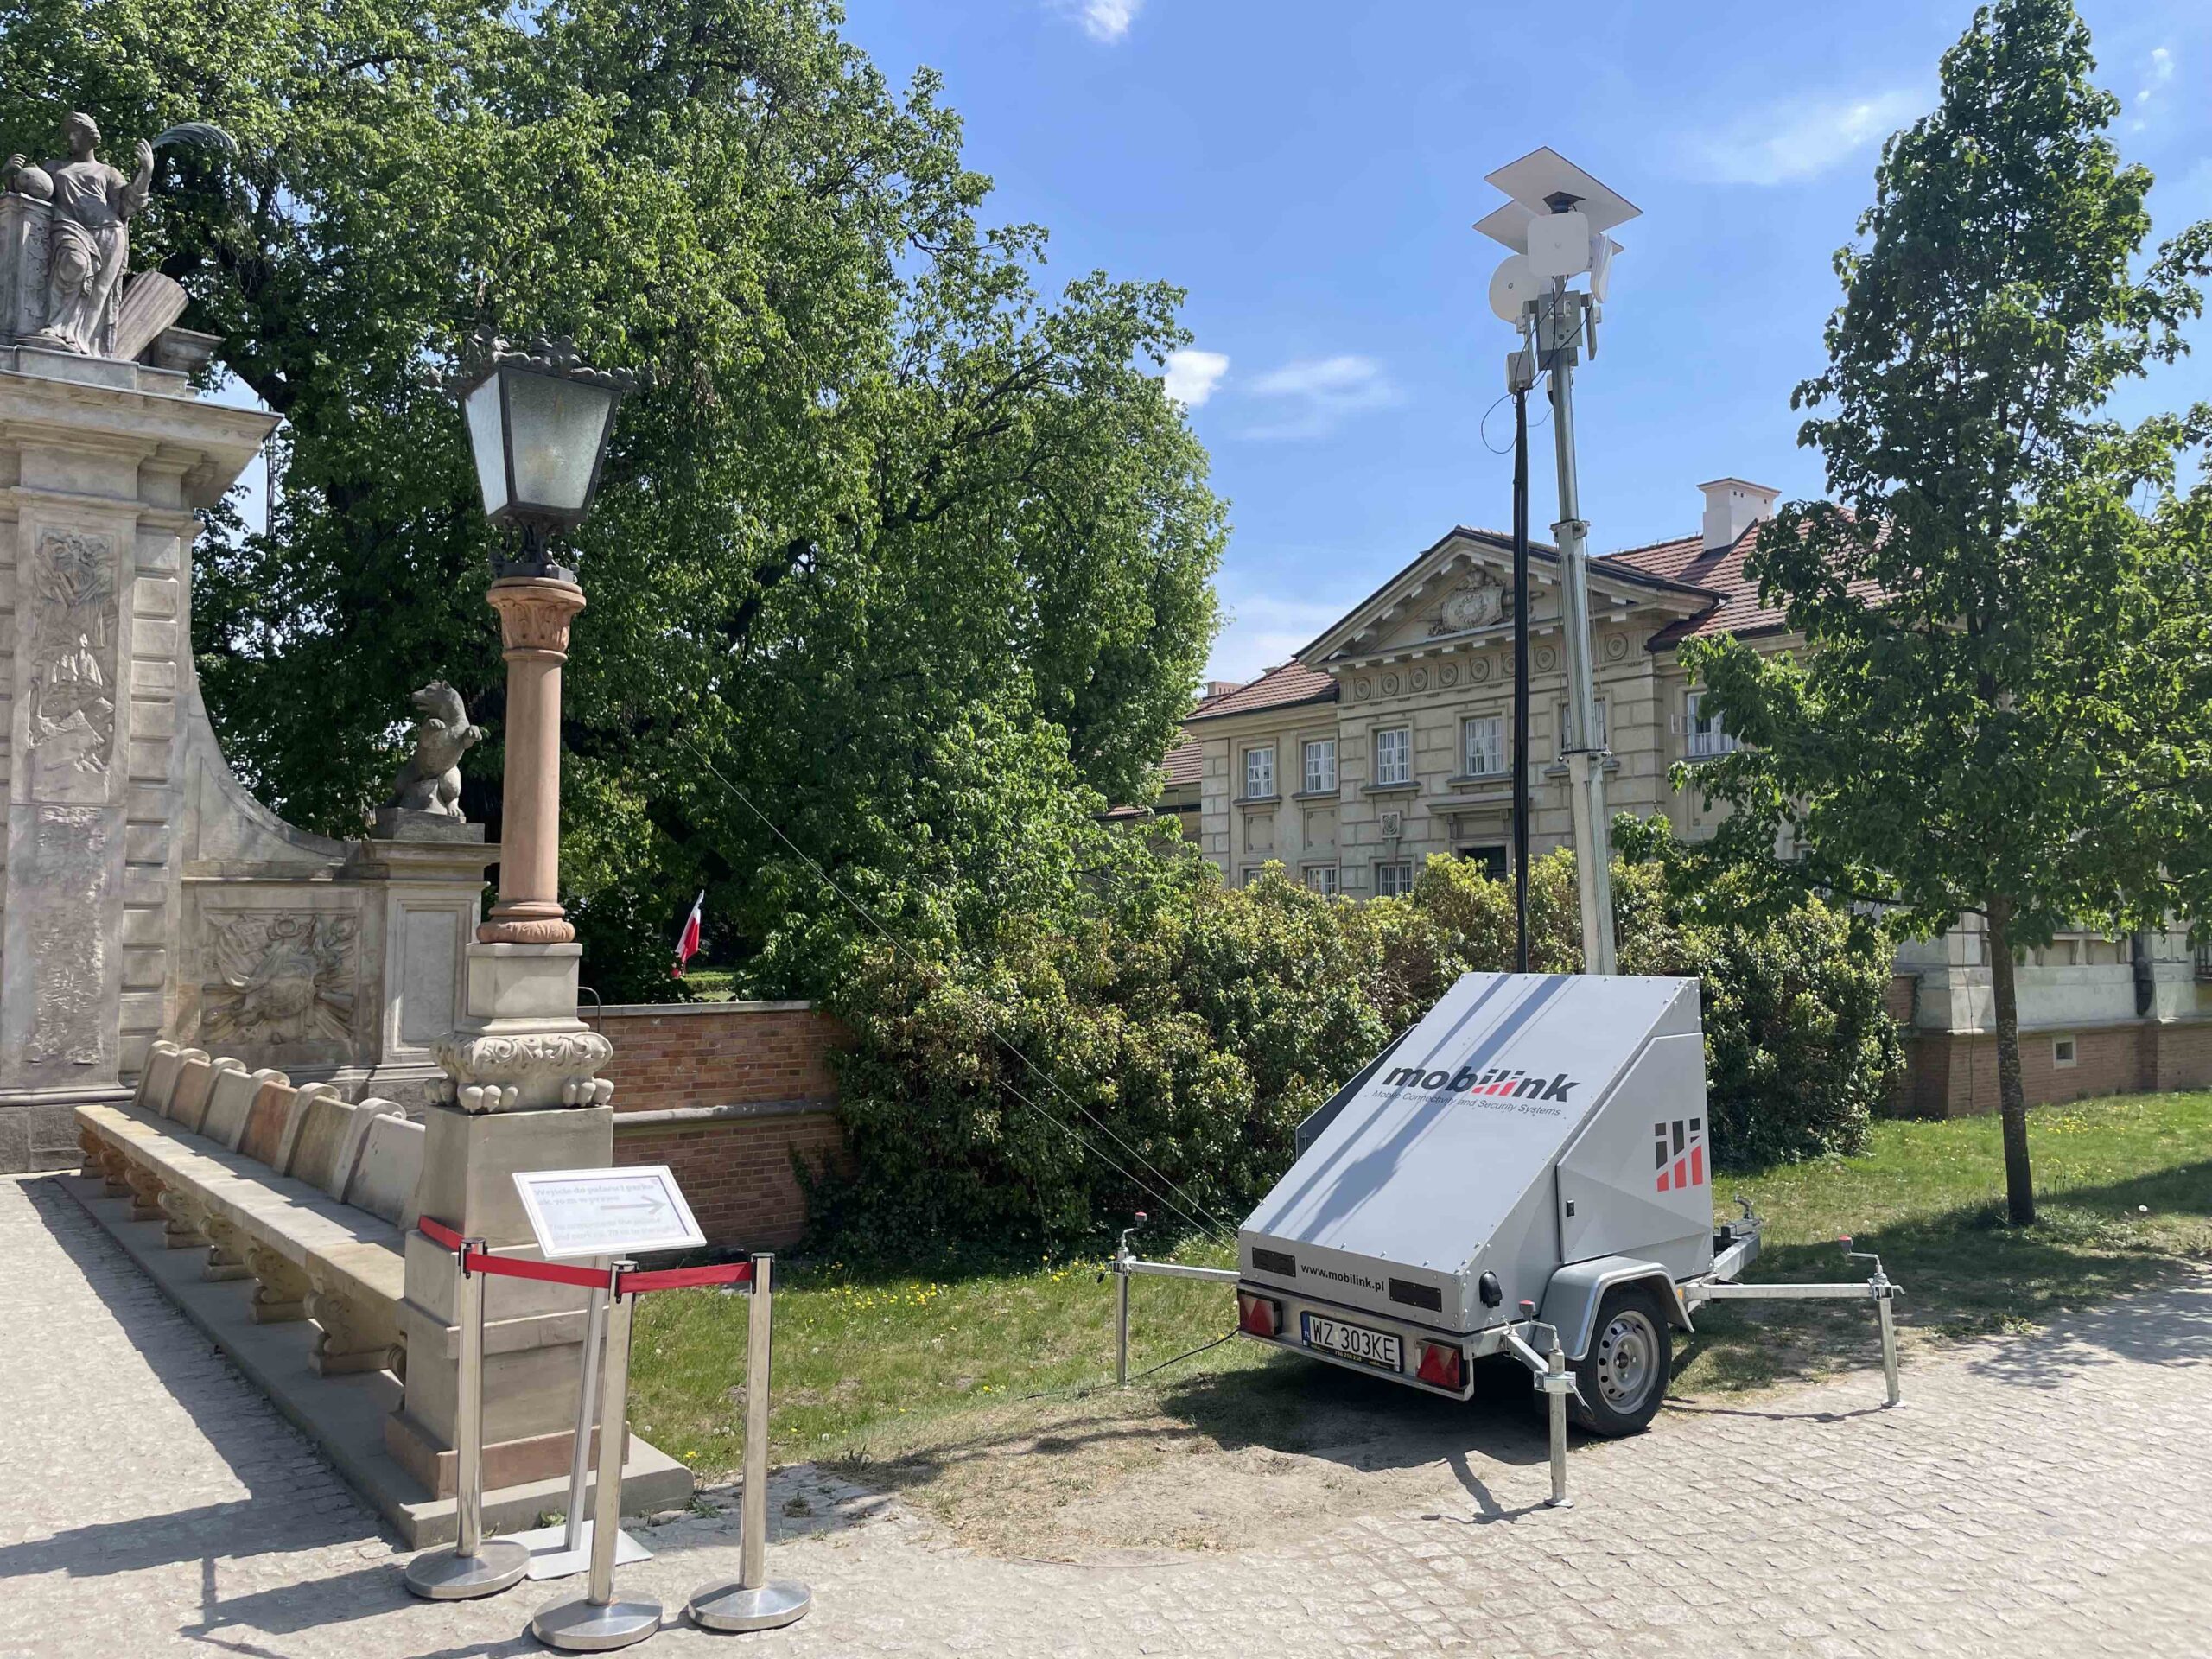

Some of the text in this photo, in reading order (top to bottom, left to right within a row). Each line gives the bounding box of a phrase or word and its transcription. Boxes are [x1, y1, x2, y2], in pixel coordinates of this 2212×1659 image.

[1382, 1066, 1580, 1103] mobilink
[1372, 1090, 1561, 1116] Mobile Connectivity and Security Systems
[1300, 1262, 1385, 1292] www.mobilink.pl
[1313, 1319, 1395, 1363] WZ 303KE
